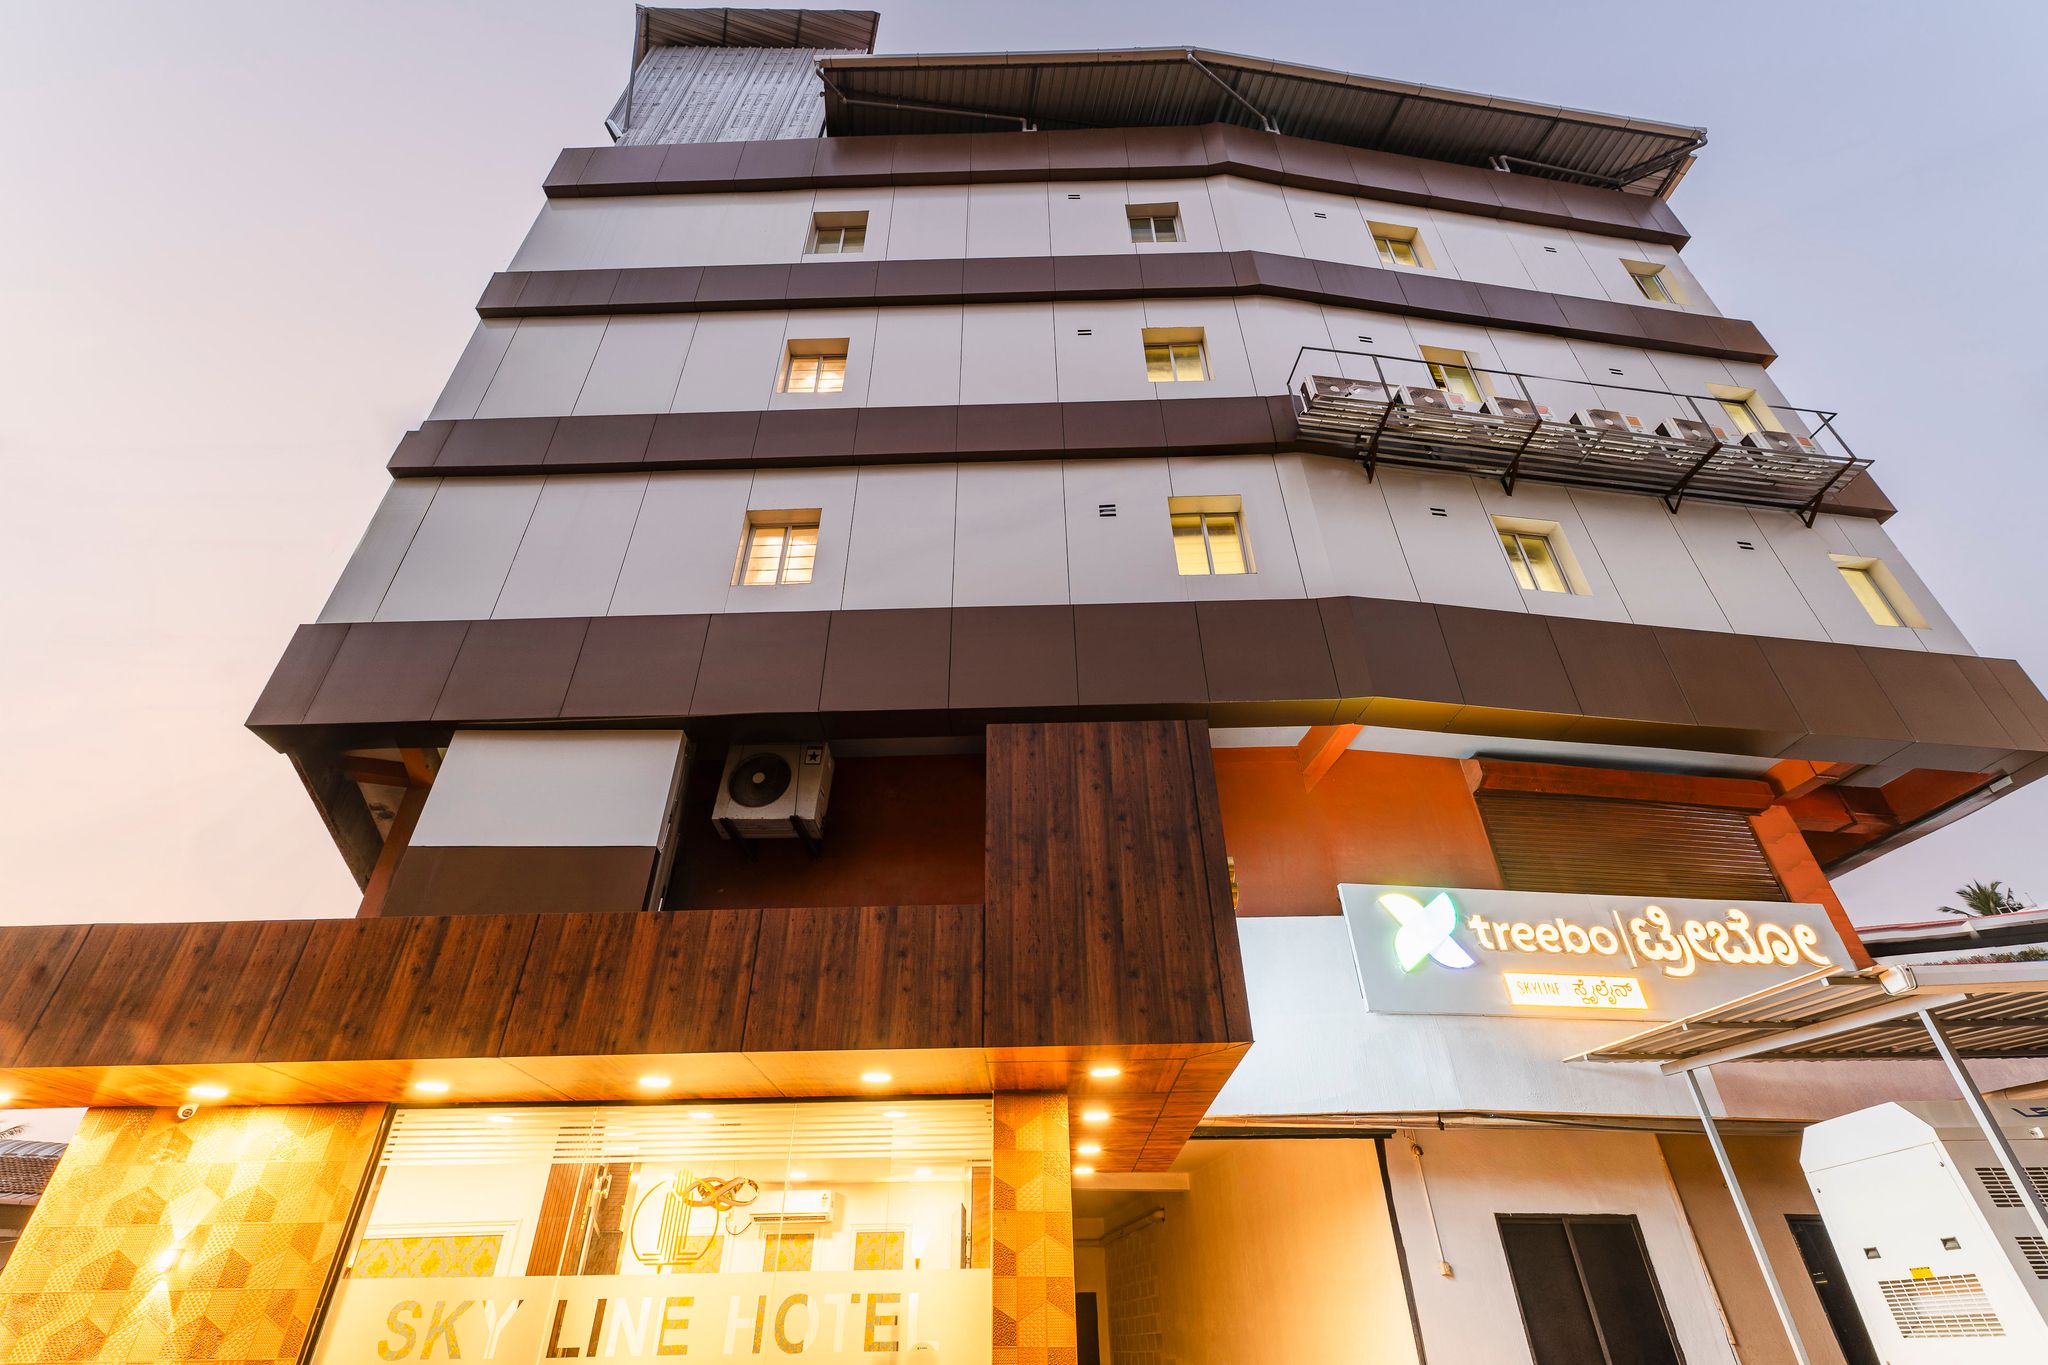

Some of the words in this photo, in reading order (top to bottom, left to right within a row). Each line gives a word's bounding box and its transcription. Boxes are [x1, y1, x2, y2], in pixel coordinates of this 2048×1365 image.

[1468, 914, 1619, 955] treebo
[378, 1299, 524, 1361] SKY
[545, 1297, 695, 1358] LINE
[722, 1293, 940, 1355] HOTEL
